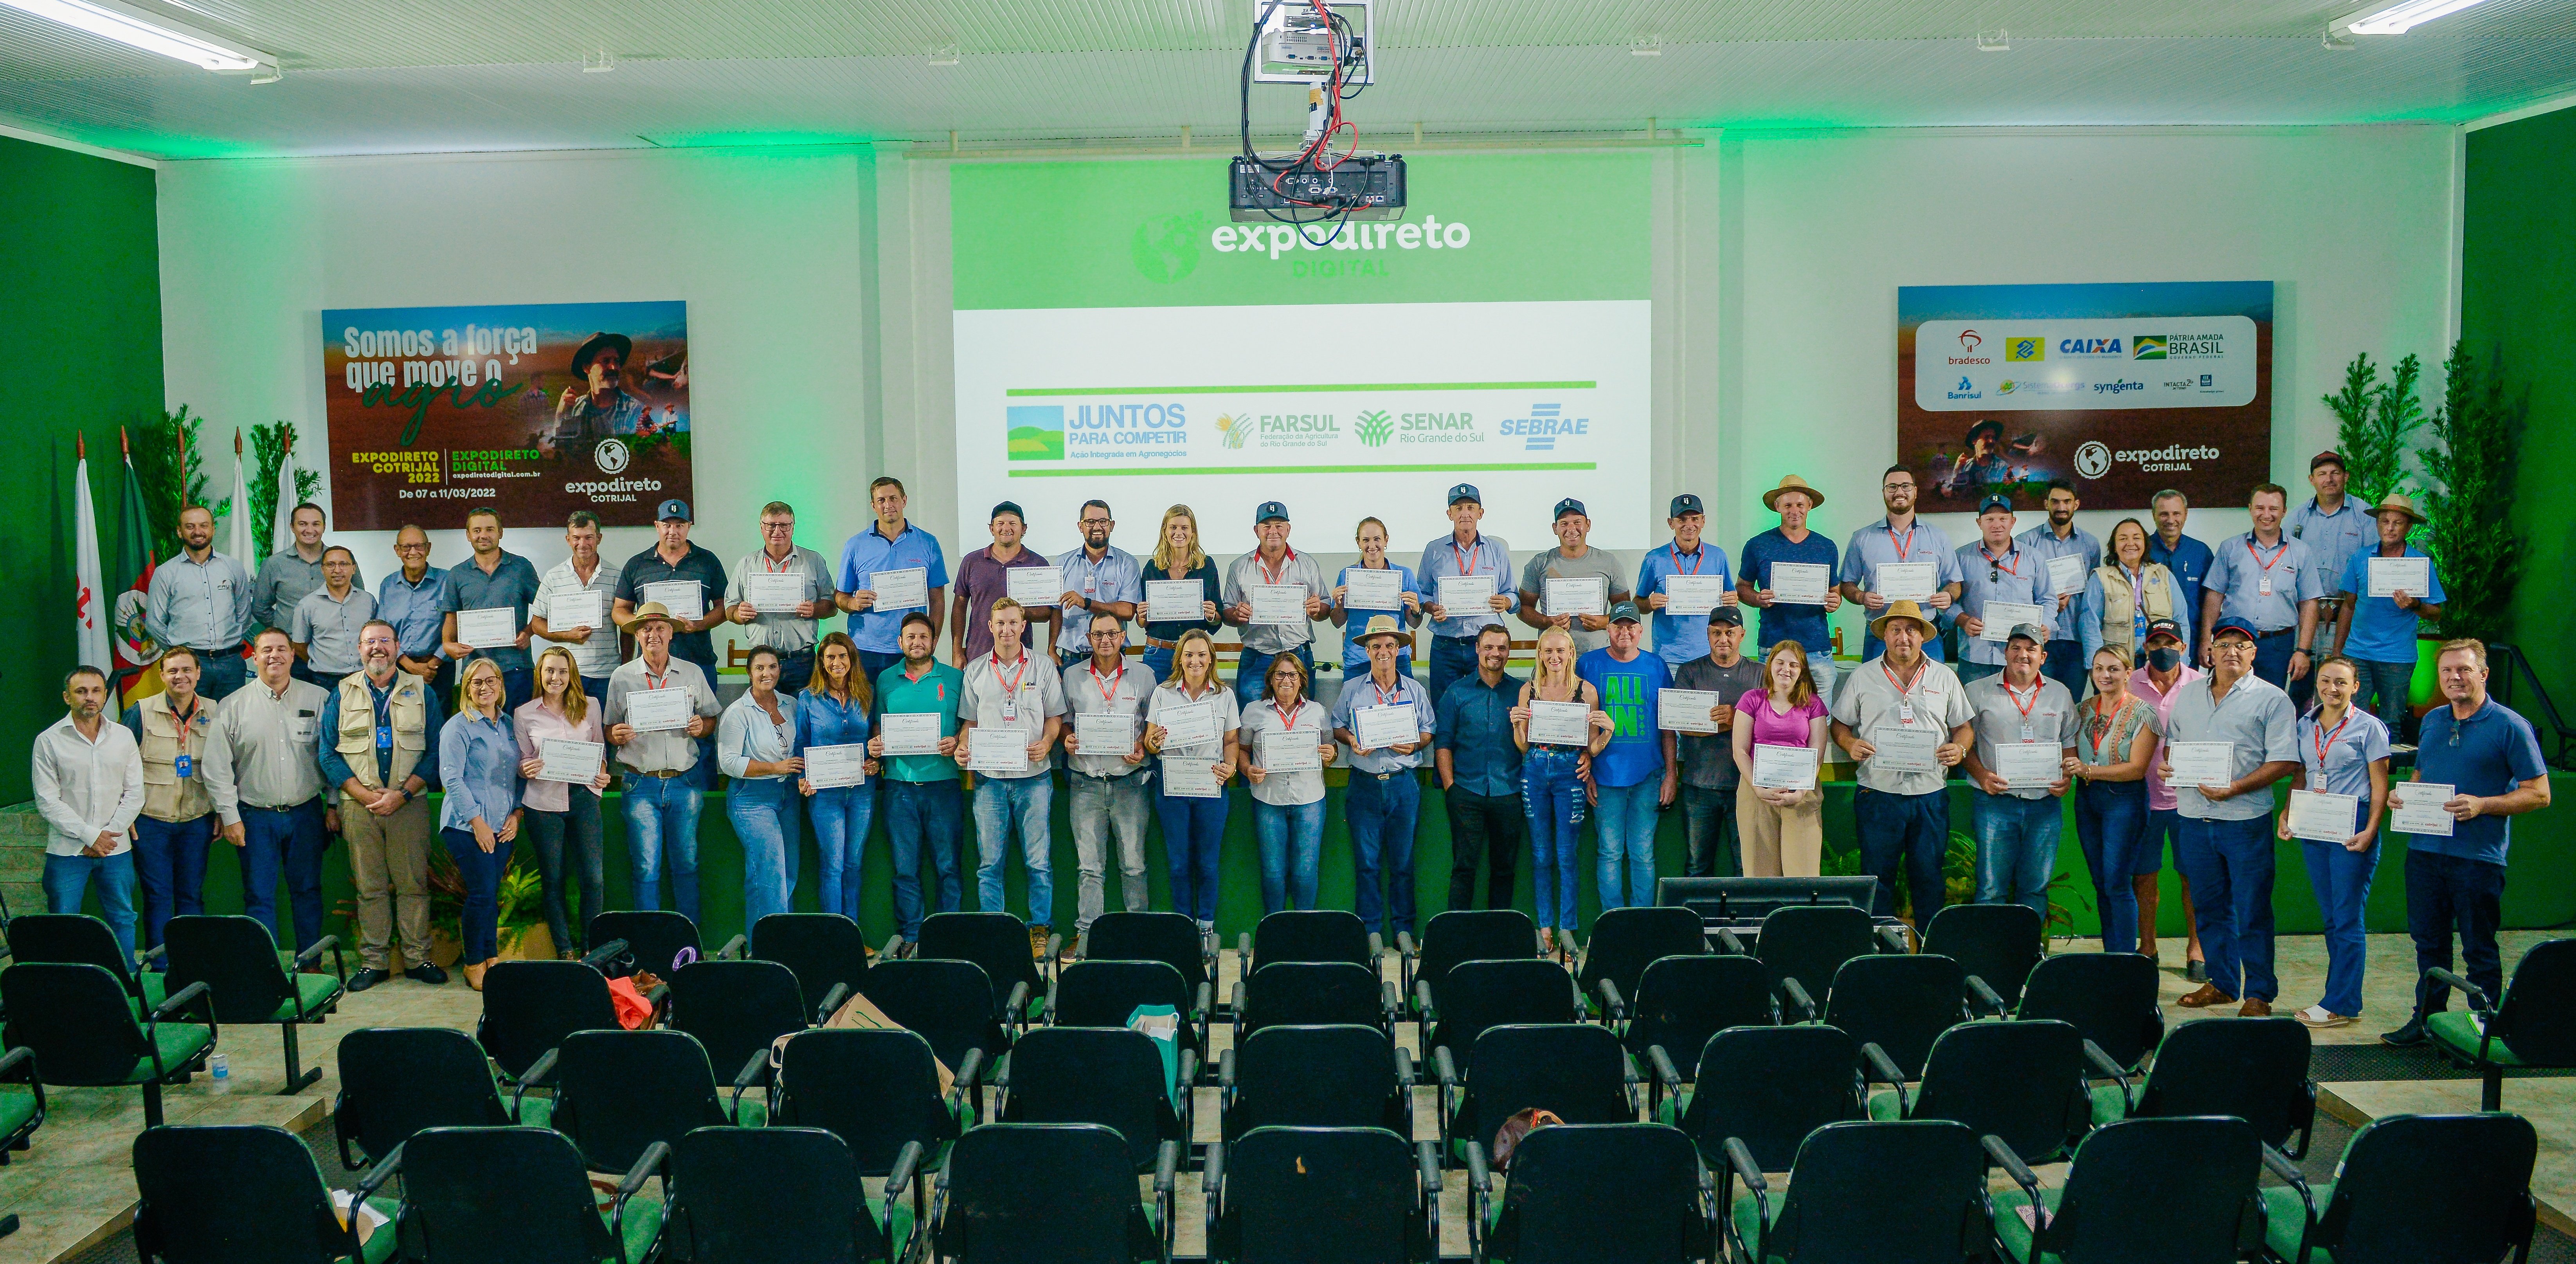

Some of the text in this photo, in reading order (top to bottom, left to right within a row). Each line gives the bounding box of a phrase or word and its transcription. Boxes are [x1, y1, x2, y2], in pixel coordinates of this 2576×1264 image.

[1293, 259, 1389, 278] DIGITAL
[344, 323, 537, 365] Somos a força
[2060, 339, 2122, 353] CAIXA
[2169, 342, 2224, 354] BRASIL
[1948, 356, 1990, 364] bradesco
[346, 359, 502, 393] que move o
[2094, 381, 2144, 394] syngenta
[363, 375, 523, 446] agro
[1069, 404, 1186, 429] JUNTOS
[1260, 415, 1340, 432] FARSUL
[1400, 413, 1473, 430] SENAR
[1500, 418, 1589, 435] SEBRAE
[1069, 431, 1186, 444] PARA COMPETIR
[1401, 432, 1485, 443] Rio Grande do Sul
[352, 451, 439, 463] EXPODIRETO
[452, 449, 540, 461] EXPODIRETO
[1090, 451, 1123, 459] Integrada
[1139, 450, 1187, 459] Agronegócios
[2115, 444, 2220, 464] expodireto
[373, 462, 440, 473] COTRIJAL
[452, 461, 507, 472] DIGITAL
[2143, 463, 2192, 472] COTRIJAL
[408, 473, 440, 483] 2022
[565, 477, 662, 496] expodireto
[399, 489, 414, 499] De
[415, 489, 428, 498] 07
[439, 488, 496, 499] 11/03/2022
[1606, 676, 1644, 705] ALL
